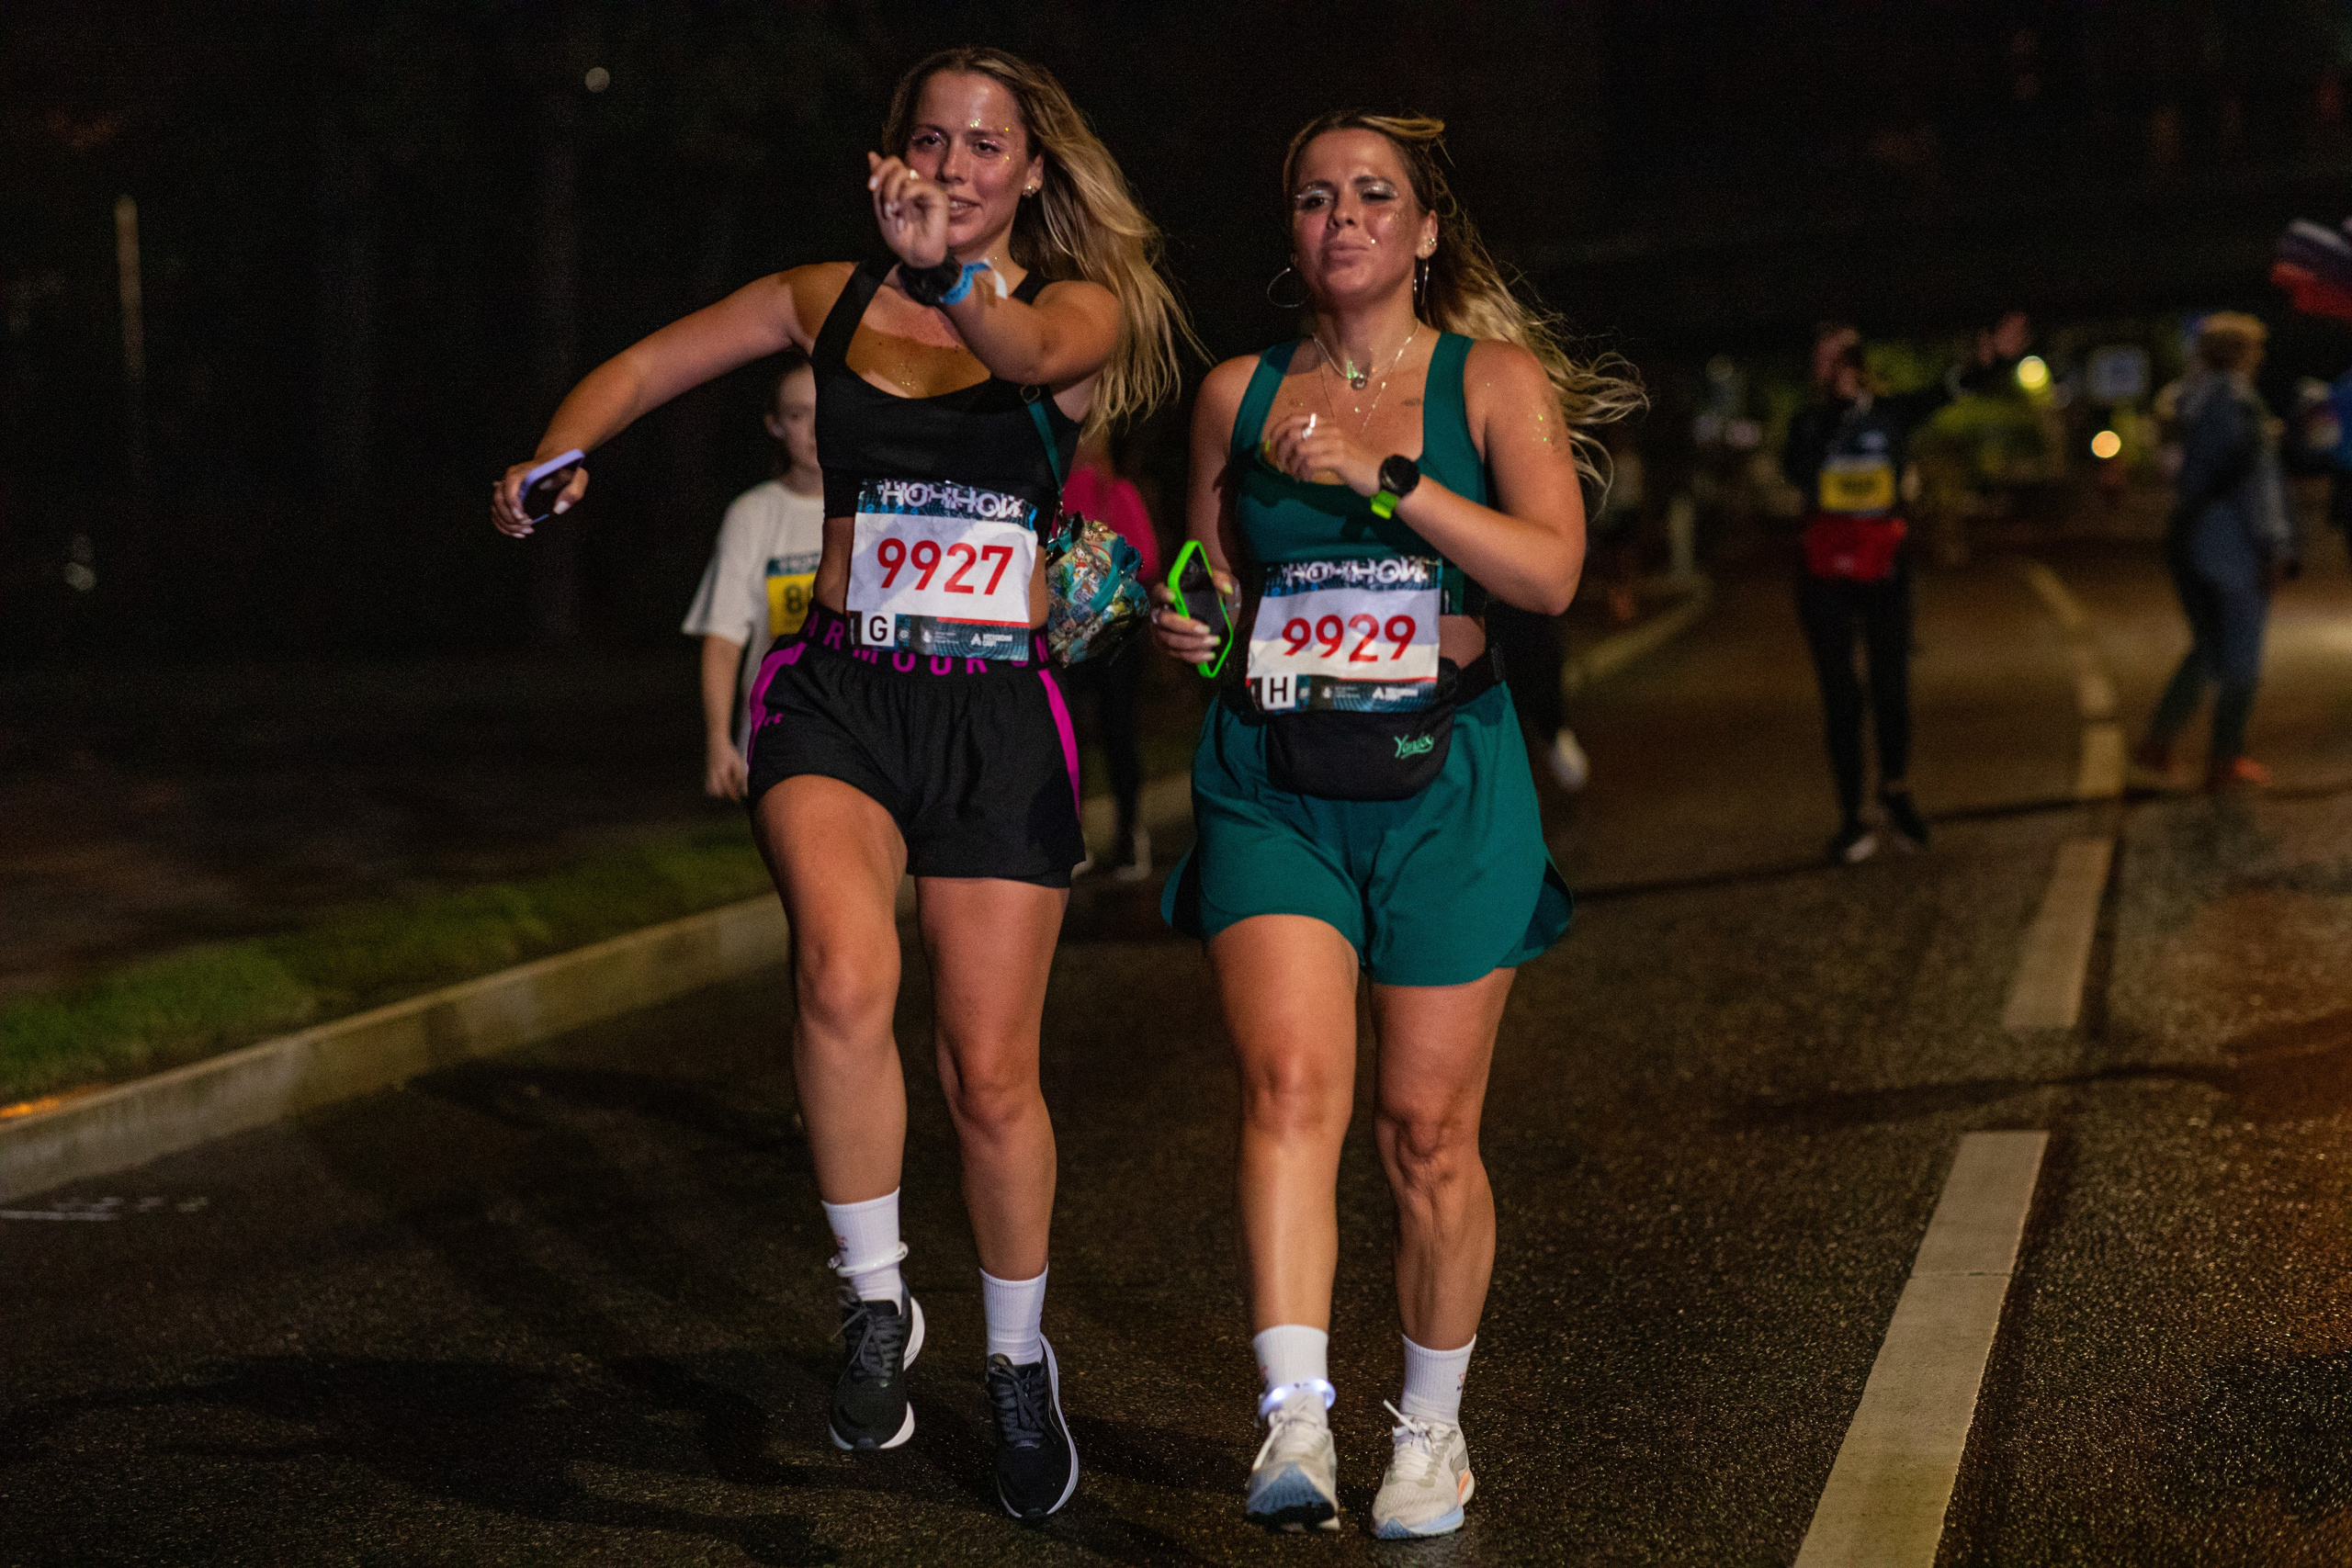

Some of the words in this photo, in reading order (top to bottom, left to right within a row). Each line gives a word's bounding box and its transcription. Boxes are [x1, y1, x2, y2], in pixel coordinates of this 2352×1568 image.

[877, 537, 1013, 596] 9927
[869, 615, 888, 642] G
[1282, 614, 1416, 662] 9929
[1270, 675, 1288, 704] H
